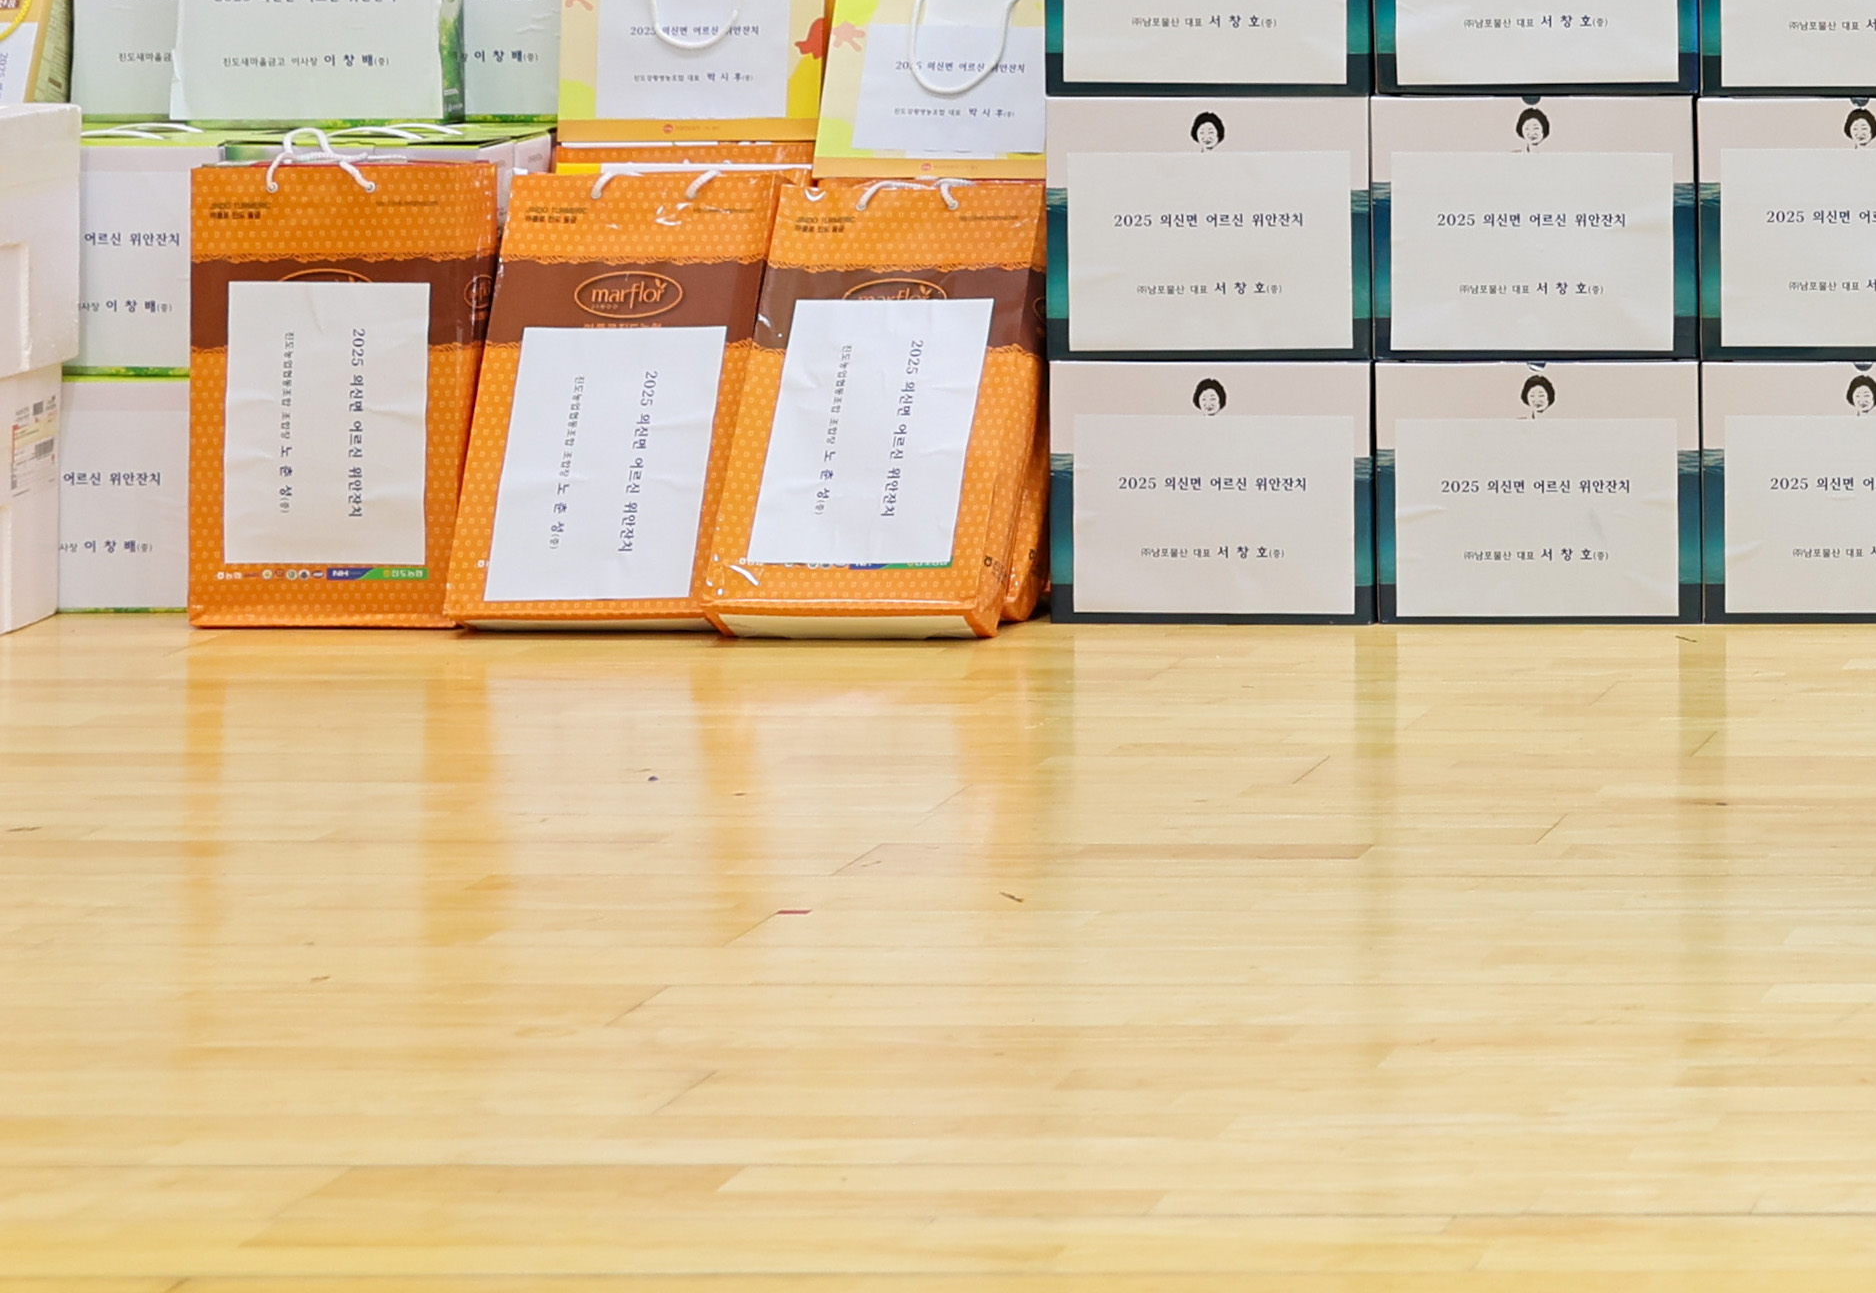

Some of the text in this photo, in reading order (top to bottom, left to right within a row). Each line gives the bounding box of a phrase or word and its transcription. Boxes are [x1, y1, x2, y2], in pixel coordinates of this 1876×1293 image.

[119, 51, 173, 63] 진도새마을금
[1113, 212, 1304, 229] 2025 의신면 어르신 위안잔치
[1436, 212, 1626, 229] 2025 의신면 어르신 위안잔치
[1766, 210, 1805, 224] 2025
[1812, 209, 1851, 225] 의신면
[83, 231, 180, 248] 어르신 위안잔치
[591, 280, 666, 309] marflor
[347, 328, 366, 518] 2025 의신면 어르신 위안잔치
[879, 339, 924, 517] 2025 의신면 어르신 위안잔치
[617, 370, 659, 552] 2025 의신면 어르신 위안잔치
[62, 471, 161, 487] 어르신 위안잔치
[1118, 476, 1307, 492] 2025 의신면 어르신 위안잔치
[1440, 478, 1630, 495] 2025 의신면 어르신 위안잔치
[1769, 477, 1809, 491] 2025
[1816, 476, 1855, 492] 의신면
